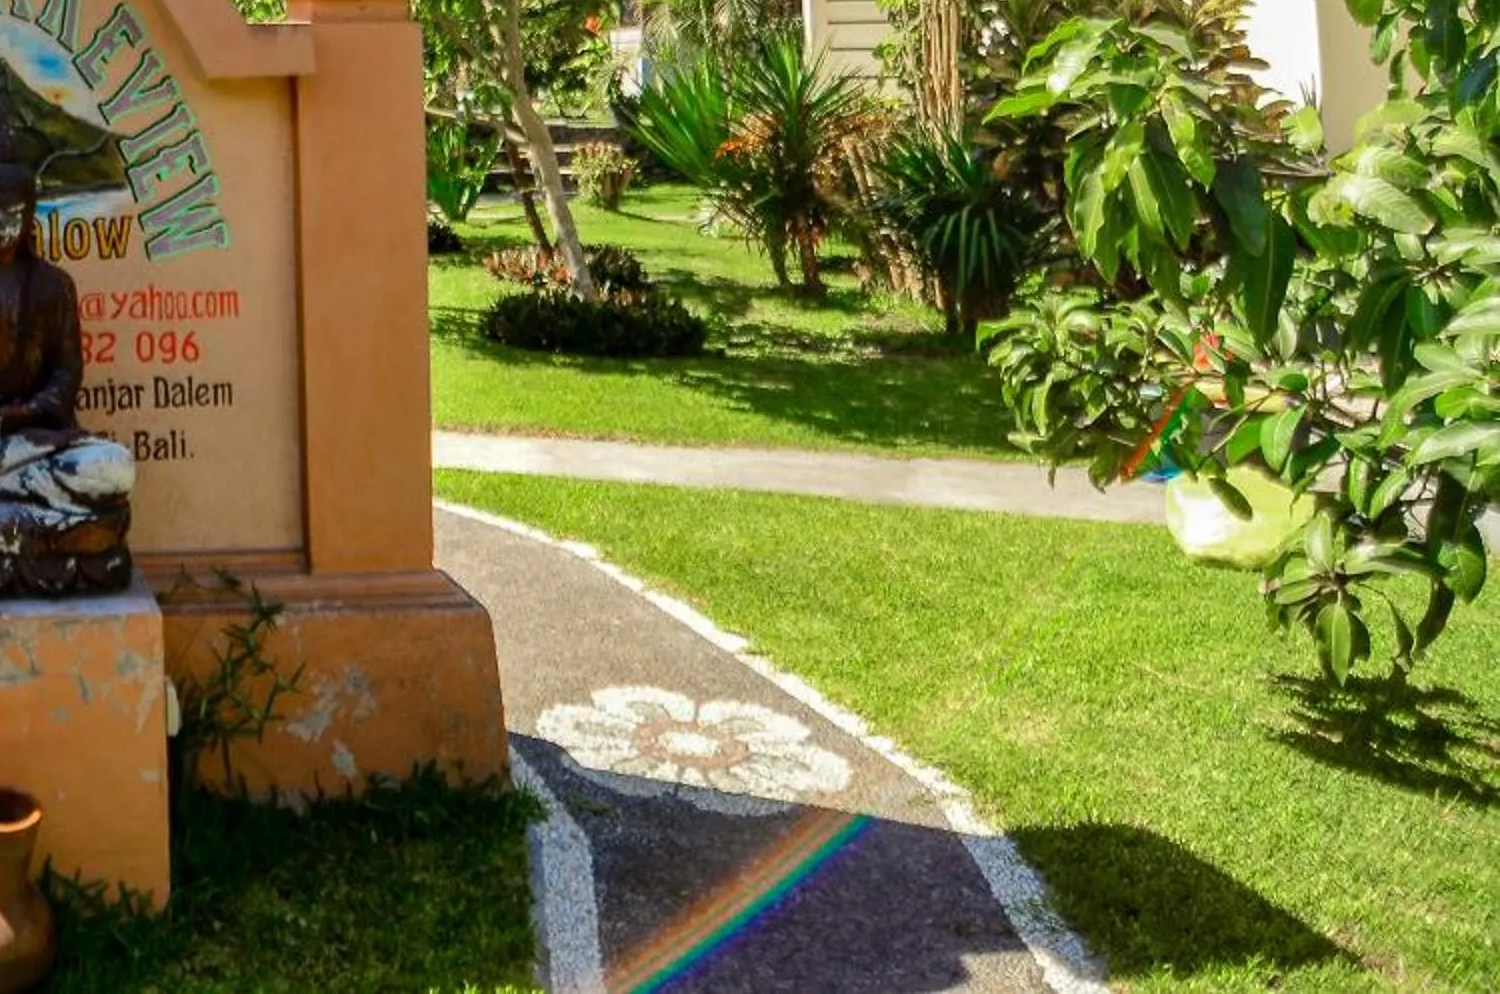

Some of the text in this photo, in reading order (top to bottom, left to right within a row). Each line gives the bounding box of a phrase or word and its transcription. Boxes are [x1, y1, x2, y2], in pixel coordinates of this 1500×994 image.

[80, 283, 240, 321] @yahoo.com
[135, 330, 201, 364] 096
[75, 376, 145, 415] anjar
[153, 375, 233, 409] Dalem
